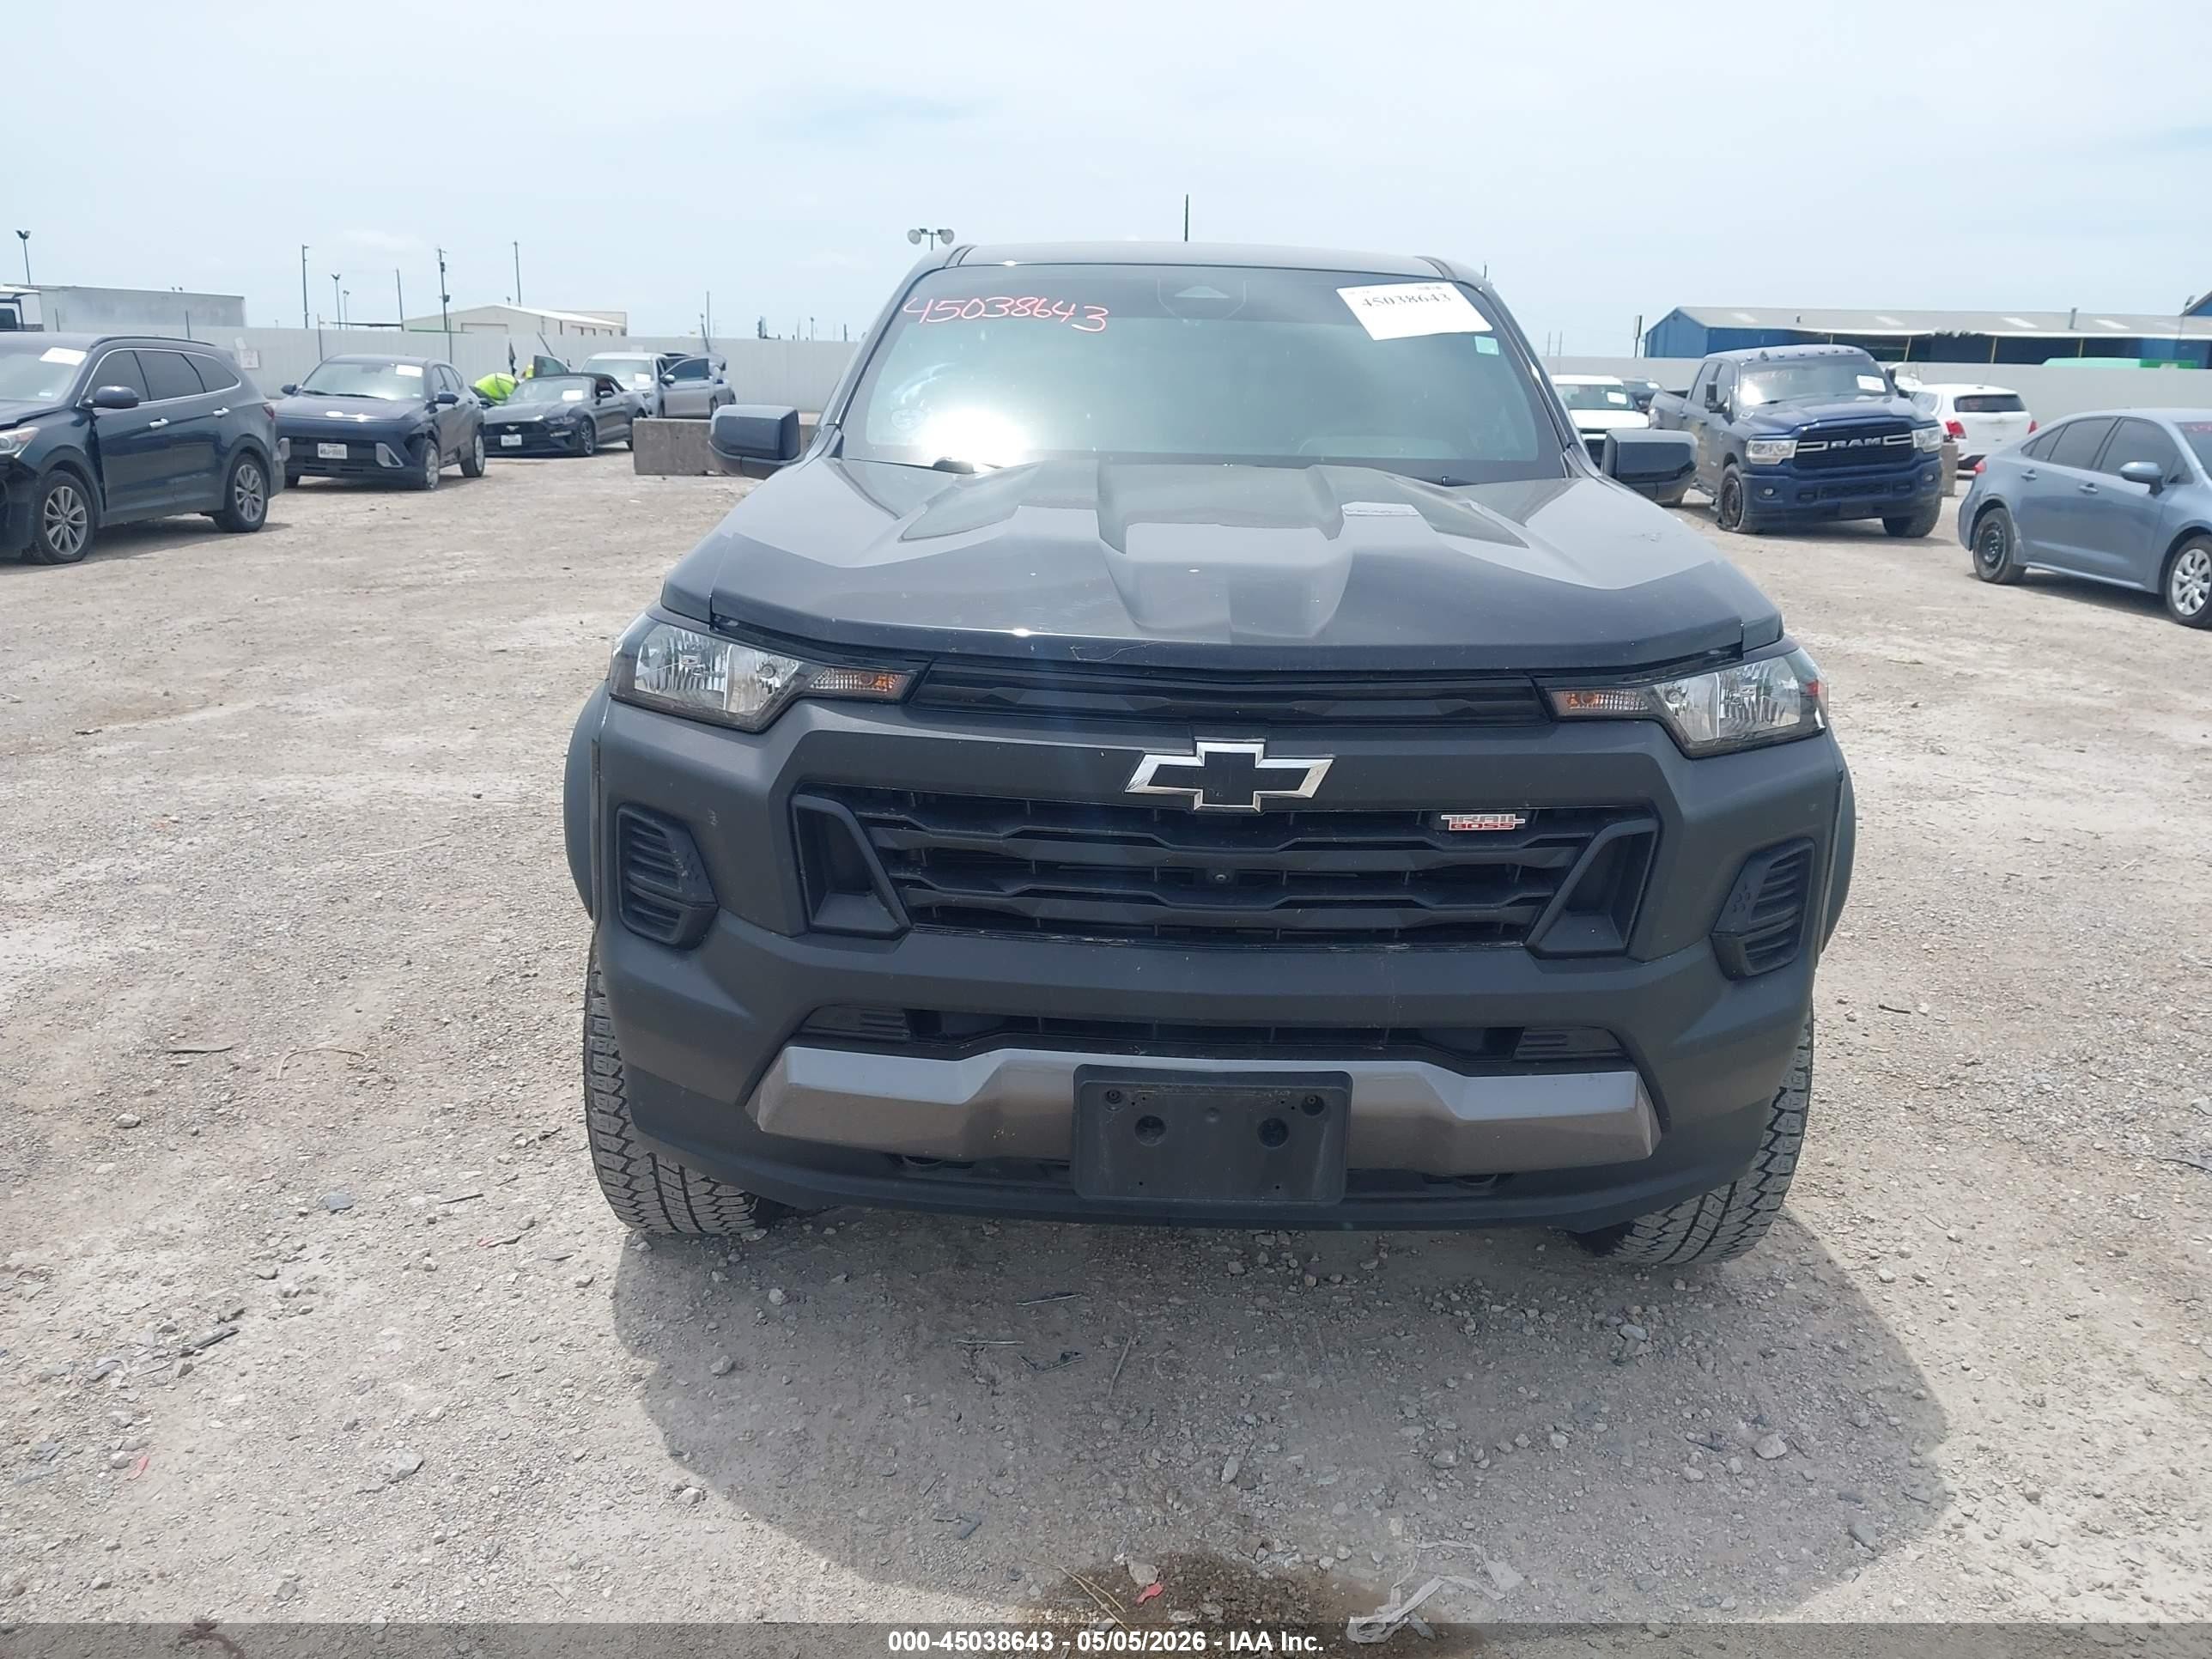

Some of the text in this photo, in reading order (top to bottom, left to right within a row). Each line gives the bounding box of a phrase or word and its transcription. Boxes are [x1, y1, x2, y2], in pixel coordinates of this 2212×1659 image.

[1362, 293, 1451, 307] 45038643
[902, 296, 1109, 332] 45038643
[1830, 437, 1881, 448] RAM
[1441, 814, 1525, 823] TRAIL
[1449, 822, 1516, 830] BOSS
